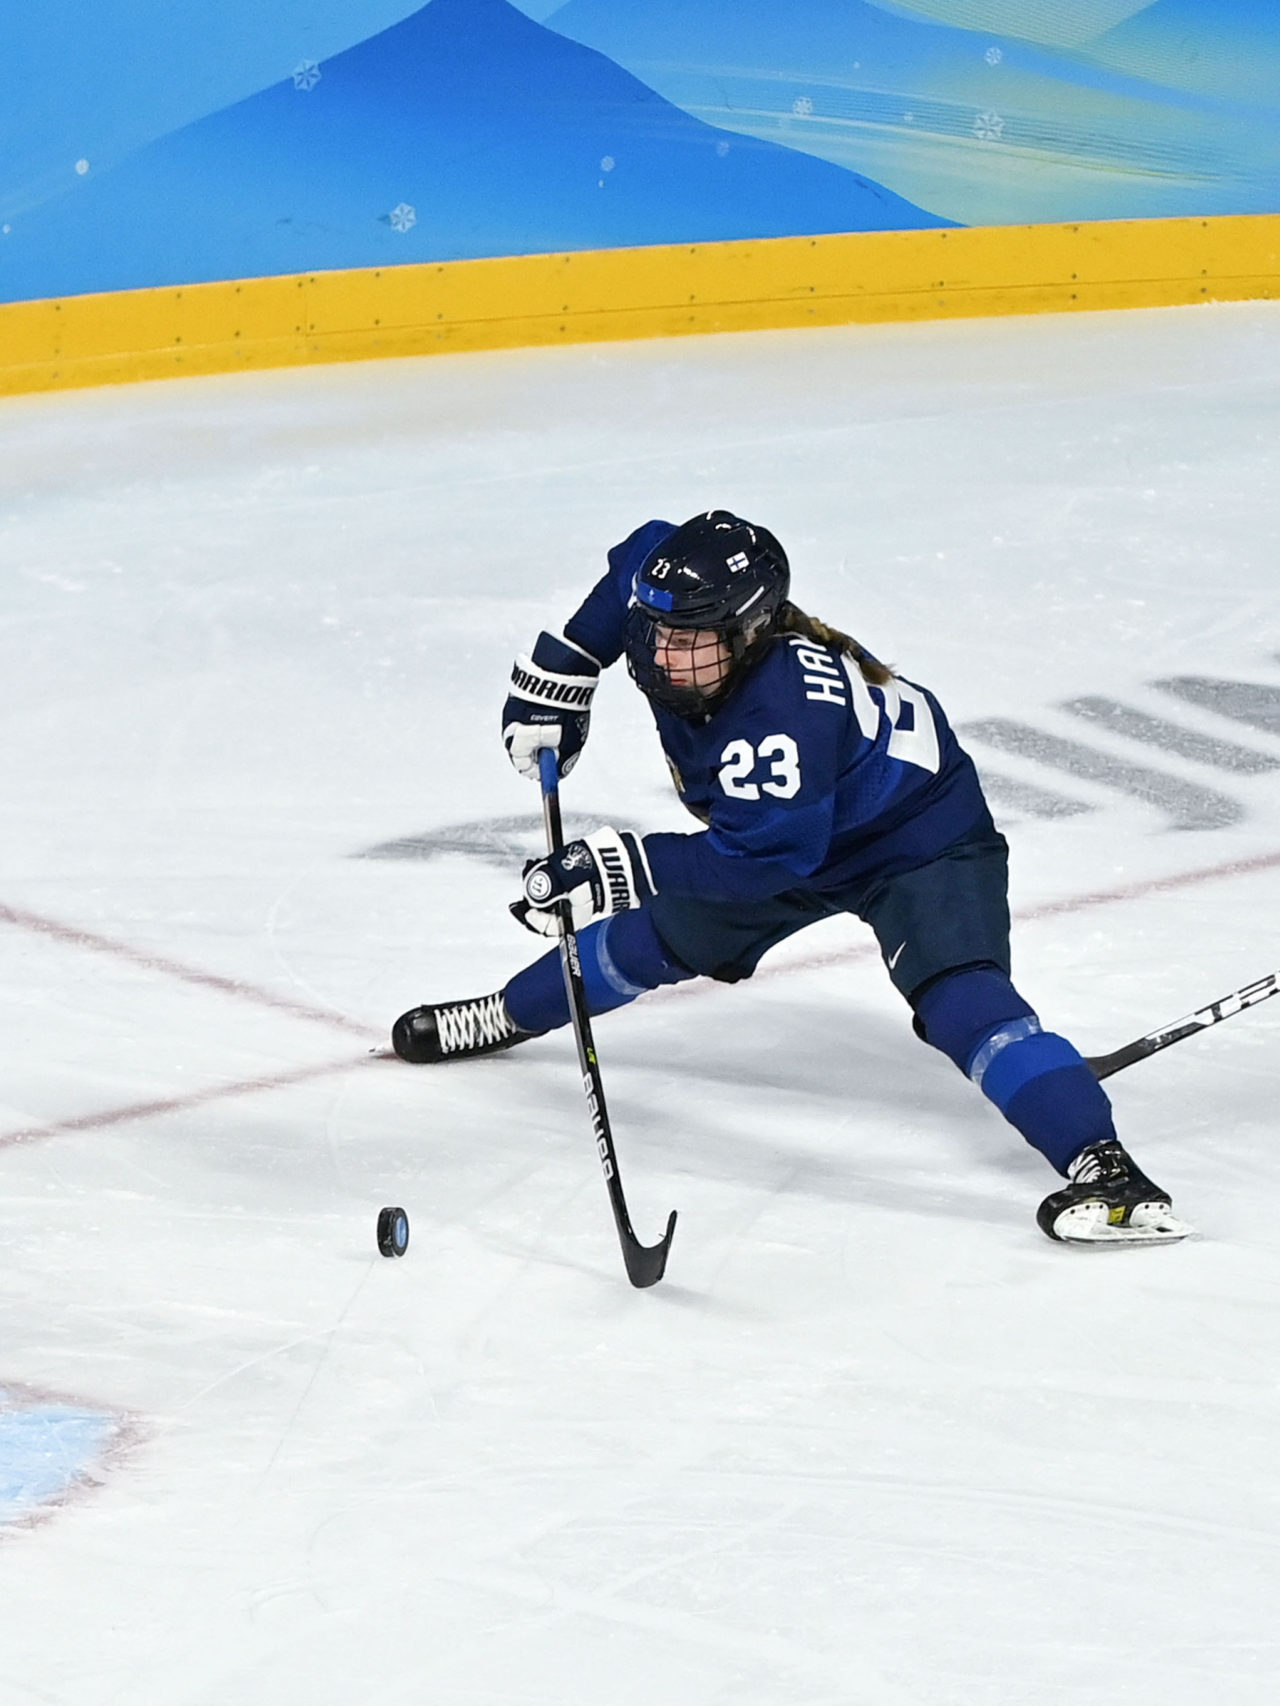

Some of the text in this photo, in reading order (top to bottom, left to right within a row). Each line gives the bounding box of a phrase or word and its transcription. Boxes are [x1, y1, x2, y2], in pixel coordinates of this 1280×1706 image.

[651, 557, 671, 579] 23
[511, 661, 595, 706] WARRIOR
[718, 733, 801, 800] 23
[566, 933, 582, 977] BAUER
